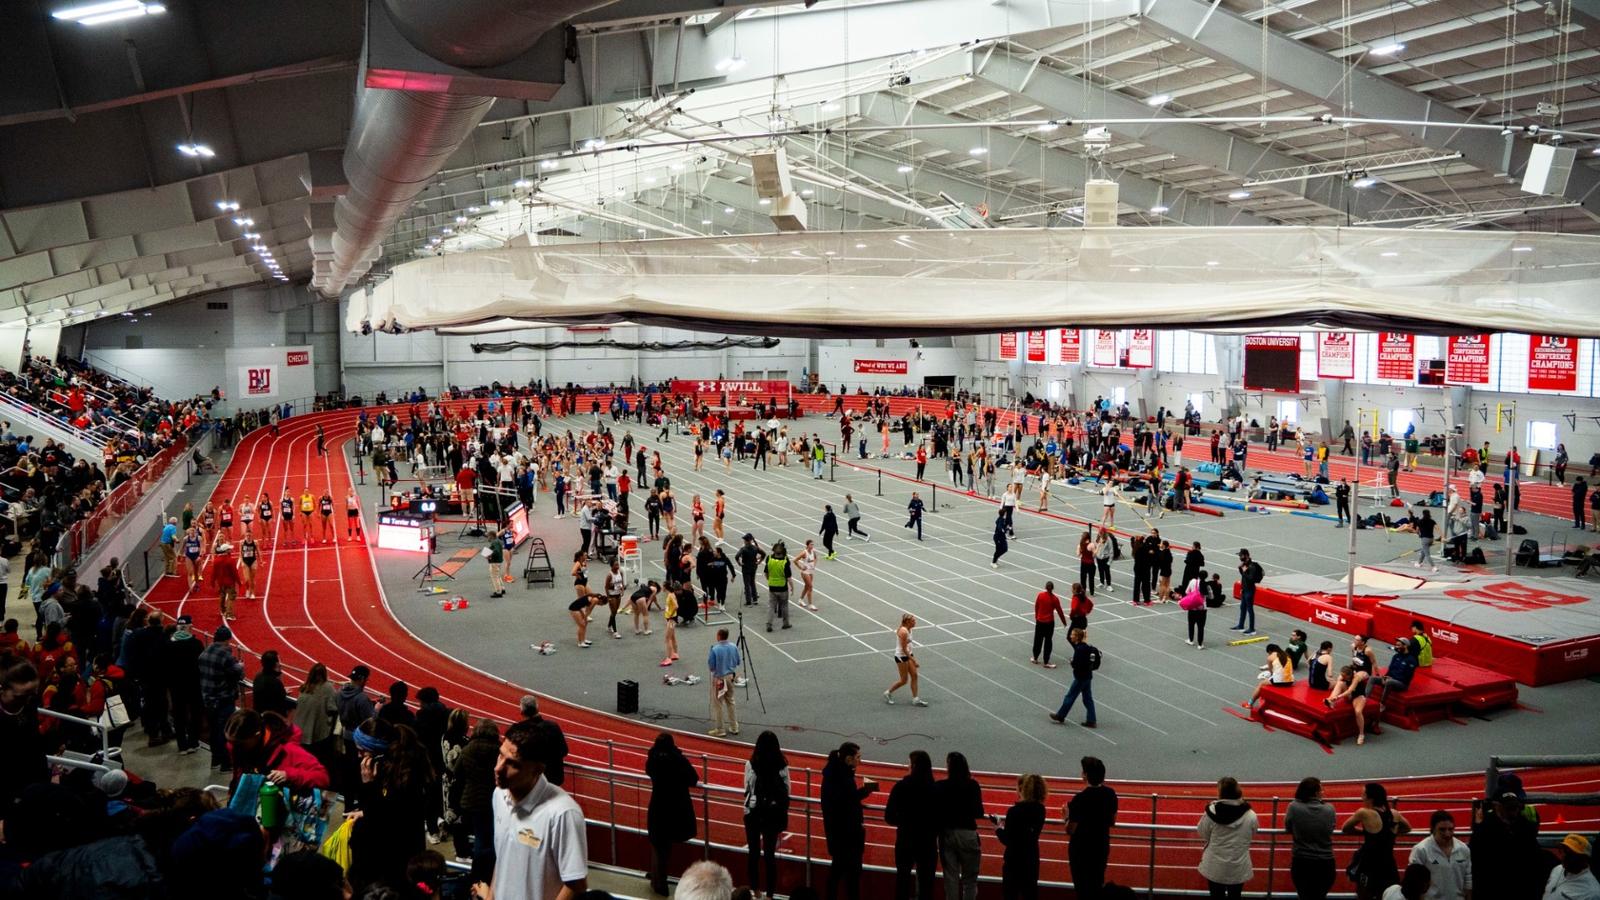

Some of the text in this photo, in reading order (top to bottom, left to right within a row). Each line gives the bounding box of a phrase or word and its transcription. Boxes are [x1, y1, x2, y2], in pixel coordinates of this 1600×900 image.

[1245, 336, 1298, 346] BOSTON UNIVERSITY
[1321, 351, 1351, 359] CHAMPIONS
[1379, 352, 1412, 360] CHAMPIONS
[1449, 354, 1487, 363] CHAMPIONS
[1535, 352, 1571, 360] CONFERENCE
[1531, 360, 1575, 369] CHAMPIONS
[248, 369, 270, 389] BU
[1315, 609, 1339, 622] UCS
[1431, 627, 1459, 641] UCS
[1564, 648, 1589, 658] UCS
